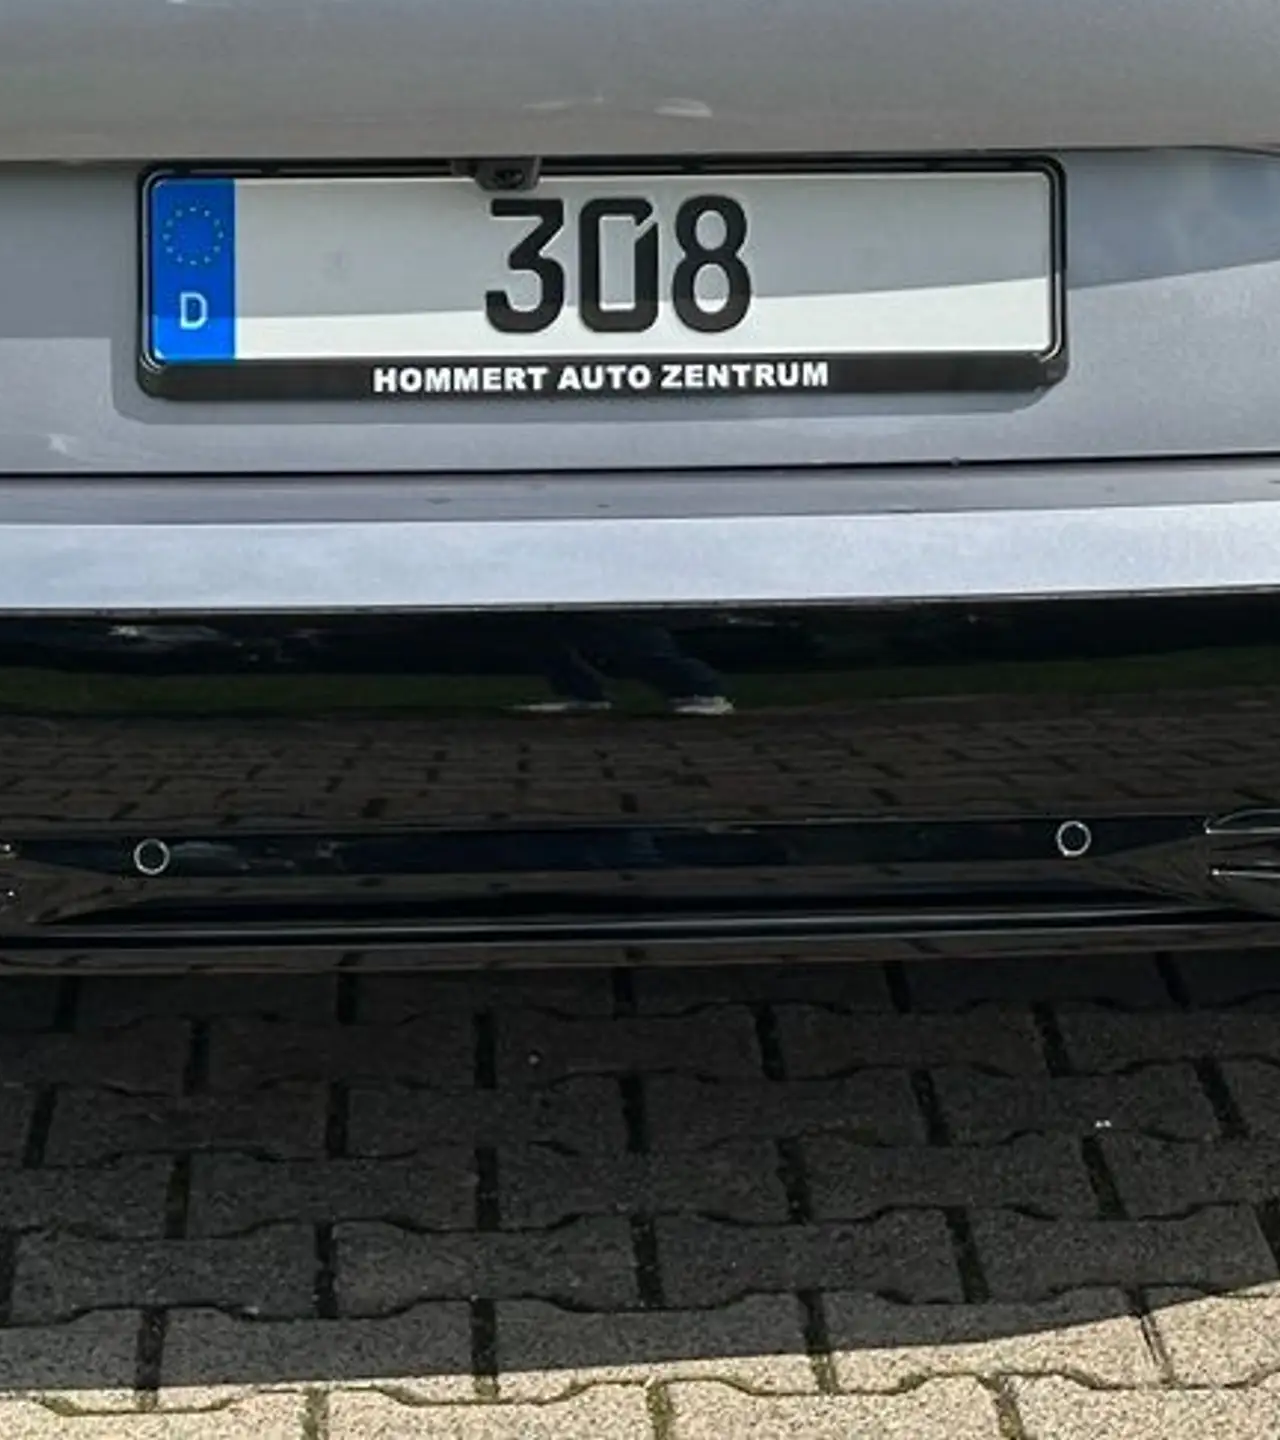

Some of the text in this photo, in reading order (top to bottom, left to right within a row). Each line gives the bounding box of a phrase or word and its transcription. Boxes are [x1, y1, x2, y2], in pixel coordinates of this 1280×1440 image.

[485, 194, 752, 333] 308
[179, 291, 209, 330] D
[373, 361, 829, 394] HOMMERT AUTO ZENTRUM
